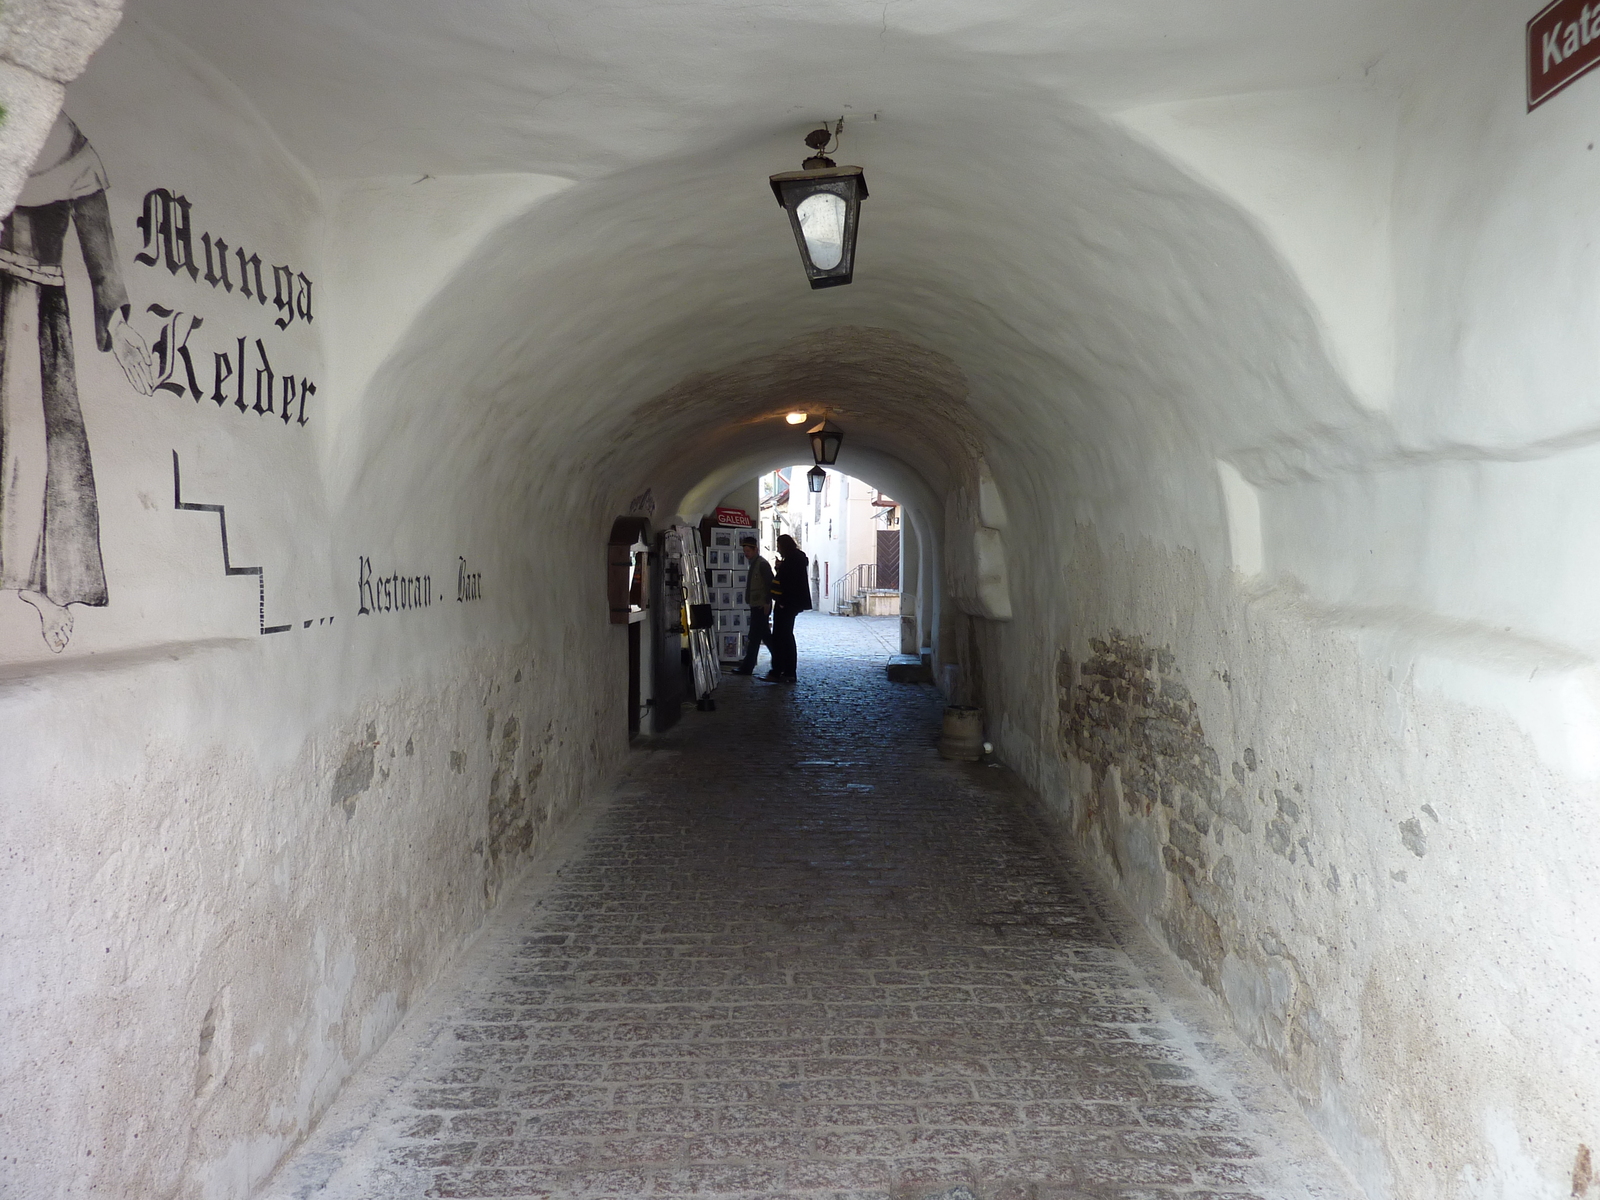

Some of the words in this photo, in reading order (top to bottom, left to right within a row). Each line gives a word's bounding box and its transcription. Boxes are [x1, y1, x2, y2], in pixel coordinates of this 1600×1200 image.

[134, 188, 314, 331] Munga
[146, 303, 317, 427] Kelder
[718, 514, 750, 525] GALERII
[357, 555, 431, 616] Restoran
